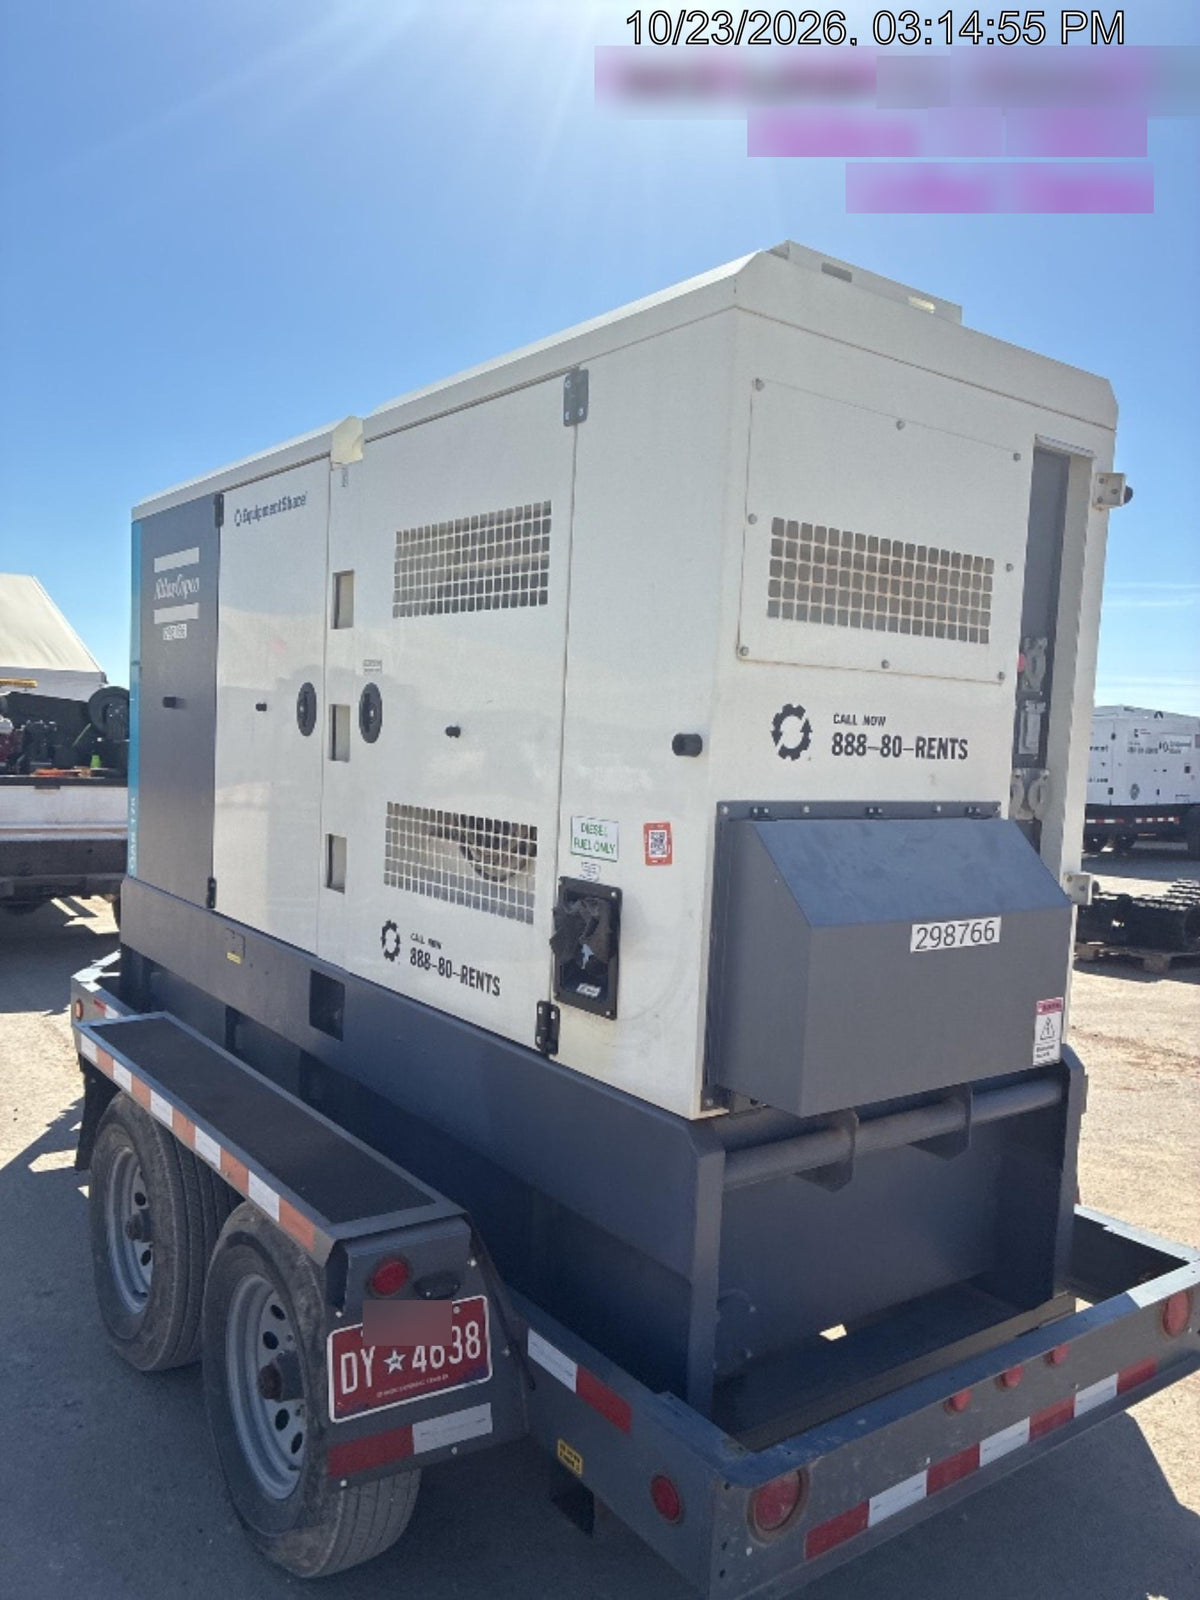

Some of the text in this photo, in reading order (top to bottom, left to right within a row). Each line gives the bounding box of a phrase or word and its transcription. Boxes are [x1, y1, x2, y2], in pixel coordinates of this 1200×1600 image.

[833, 713, 886, 727] CALL NOW
[831, 732, 968, 760] 888-80-RENTS
[574, 837, 616, 855] FUEL ONLY
[410, 932, 426, 945] CALL
[915, 920, 996, 950] 298766
[410, 946, 501, 997] 888-80-RENTS
[340, 1346, 376, 1395] DY
